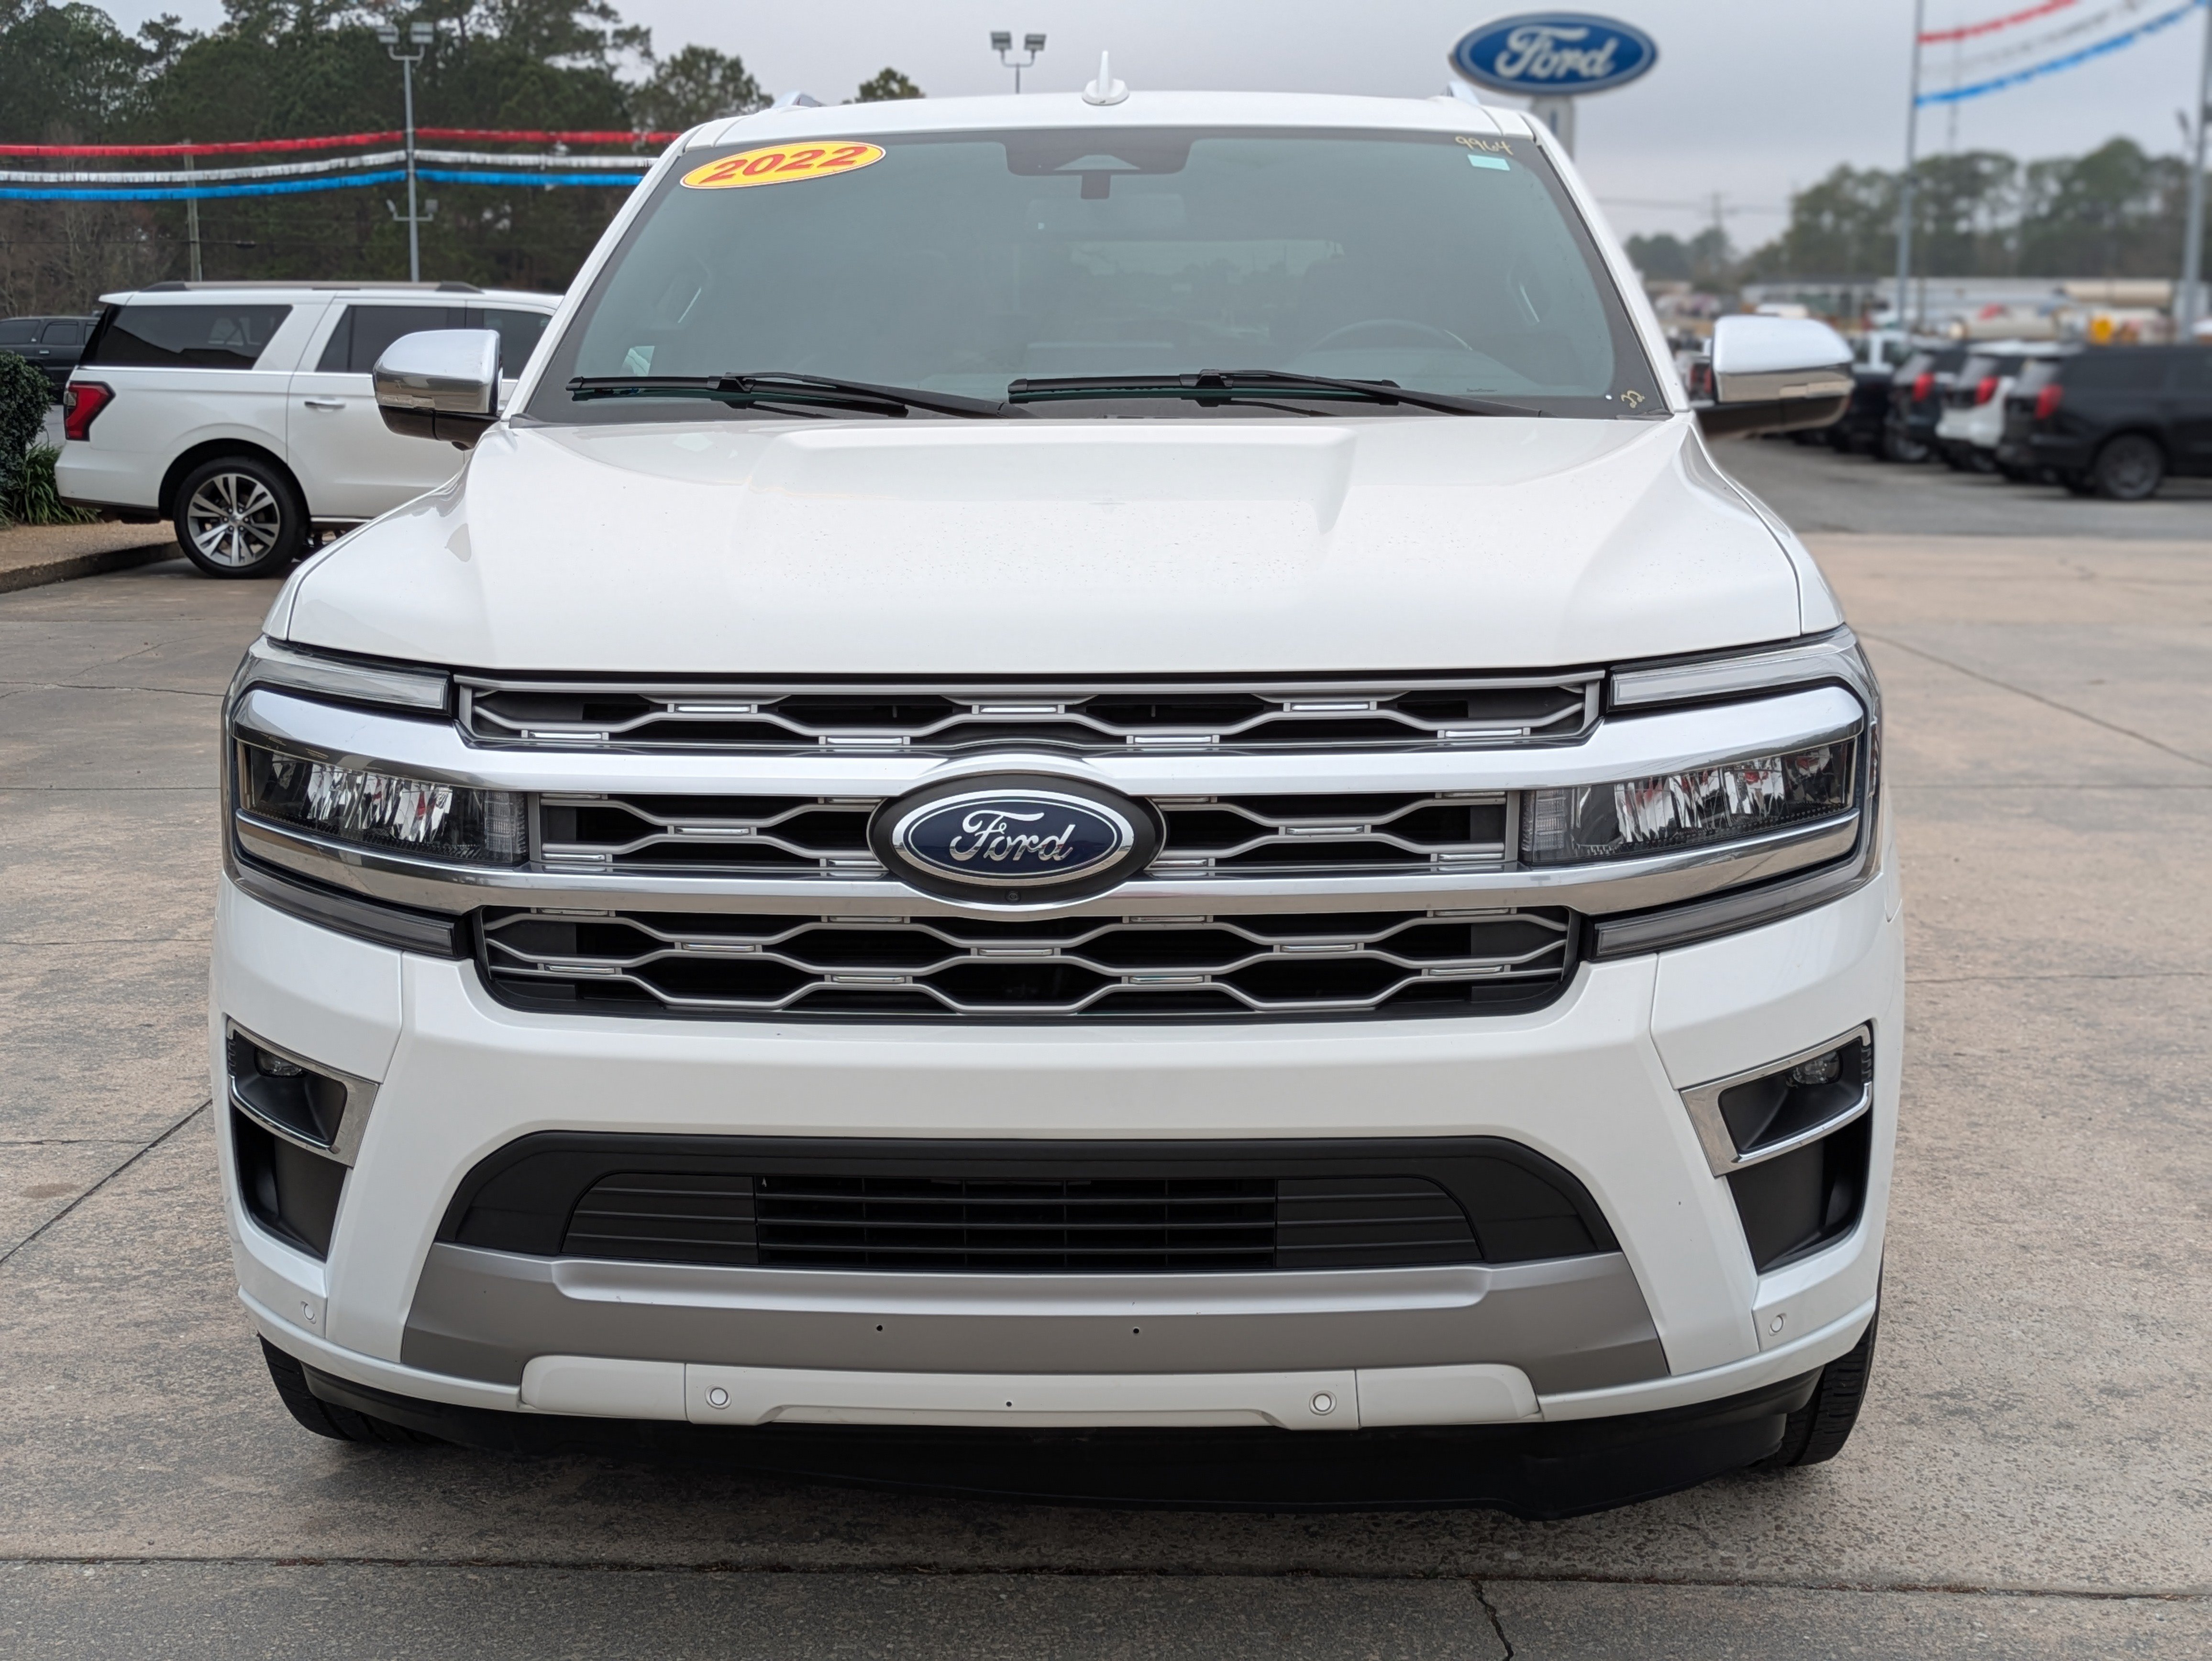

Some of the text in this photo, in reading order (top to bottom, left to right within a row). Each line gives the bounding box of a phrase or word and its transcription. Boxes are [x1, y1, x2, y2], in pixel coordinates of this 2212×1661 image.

[1495, 25, 1619, 78] Ford
[698, 146, 868, 184] 2022
[949, 809, 1076, 861] Ford
